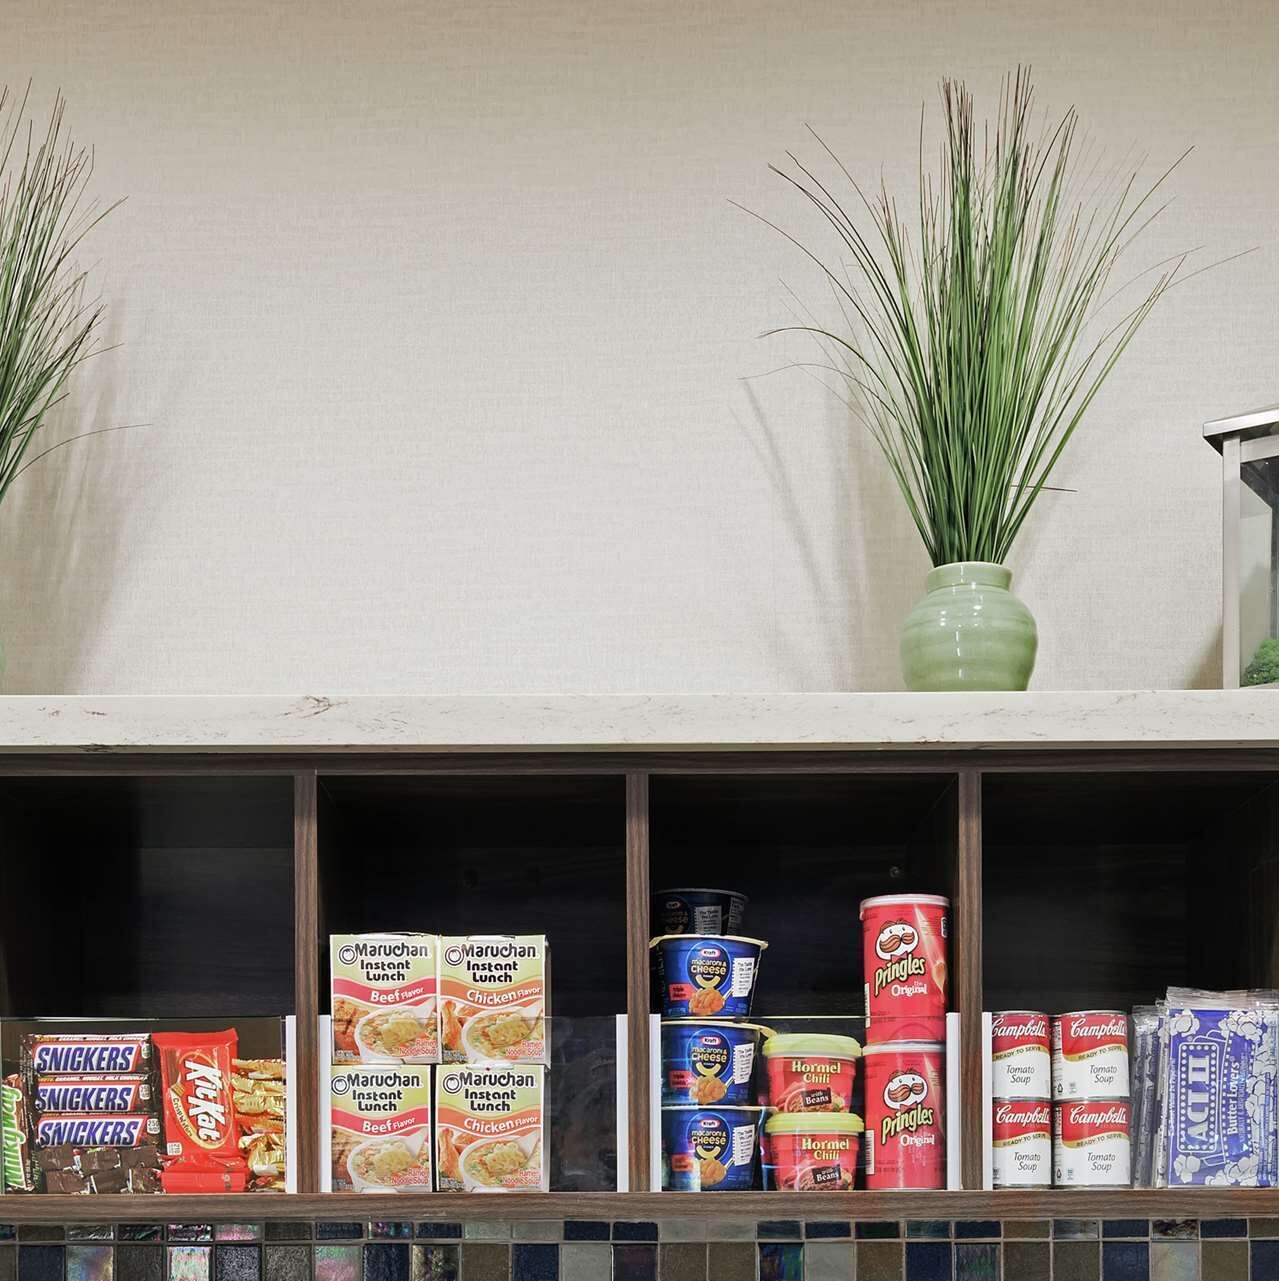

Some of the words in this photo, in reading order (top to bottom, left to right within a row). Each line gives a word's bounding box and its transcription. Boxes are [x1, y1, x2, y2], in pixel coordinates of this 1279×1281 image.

[354, 942, 428, 957] Maruchan
[461, 943, 536, 958] Maruchan
[360, 960, 411, 971] Instant
[466, 960, 519, 972] Instant
[366, 971, 406, 981] Lunch
[472, 972, 513, 983] Lunch
[874, 953, 926, 997] Pringles
[370, 989, 400, 1003] Beef
[401, 987, 424, 999] Flavor
[466, 989, 517, 1004] Chicken
[517, 987, 541, 998] Flavor
[891, 983, 928, 997] Original
[36, 1046, 135, 1072] SNICKERS
[995, 1051, 1014, 1061] READY
[1078, 1051, 1098, 1061] READY
[791, 1060, 841, 1073] Hormel
[1006, 1064, 1035, 1074] Tomato
[1089, 1064, 1118, 1074] Tomato
[1187, 1054, 1211, 1085] II
[346, 1072, 420, 1087] Maruchan
[459, 1071, 535, 1087] Maruchan
[803, 1073, 830, 1083] Chili
[1010, 1074, 1031, 1086] Soup
[1094, 1074, 1114, 1086] Soup
[1226, 1060, 1240, 1098] Lovers
[37, 1087, 132, 1111] SNICKERS
[352, 1090, 403, 1101] Instant
[464, 1088, 517, 1101] Instant
[805, 1095, 829, 1105] Beans
[357, 1101, 397, 1111] Lunch
[470, 1100, 511, 1112] Lunch
[1186, 1089, 1210, 1142] ACT
[1226, 1098, 1240, 1135] Butter
[362, 1119, 392, 1133] Beef
[392, 1117, 416, 1129] Flavor
[463, 1117, 515, 1133] Chicken
[514, 1116, 539, 1127] Flavor
[881, 1104, 934, 1145] Pringles
[38, 1120, 140, 1146] SNICKERS
[801, 1137, 849, 1150] Hormel
[900, 1133, 935, 1147] Original
[1003, 1138, 1022, 1146] READY
[1076, 1138, 1096, 1147] READY
[813, 1150, 840, 1161] Chili
[1013, 1151, 1041, 1162] Tomato
[1087, 1152, 1116, 1162] Tomato
[1017, 1161, 1037, 1173] Soup
[1091, 1161, 1112, 1173] Soup
[815, 1171, 839, 1182] Beans
